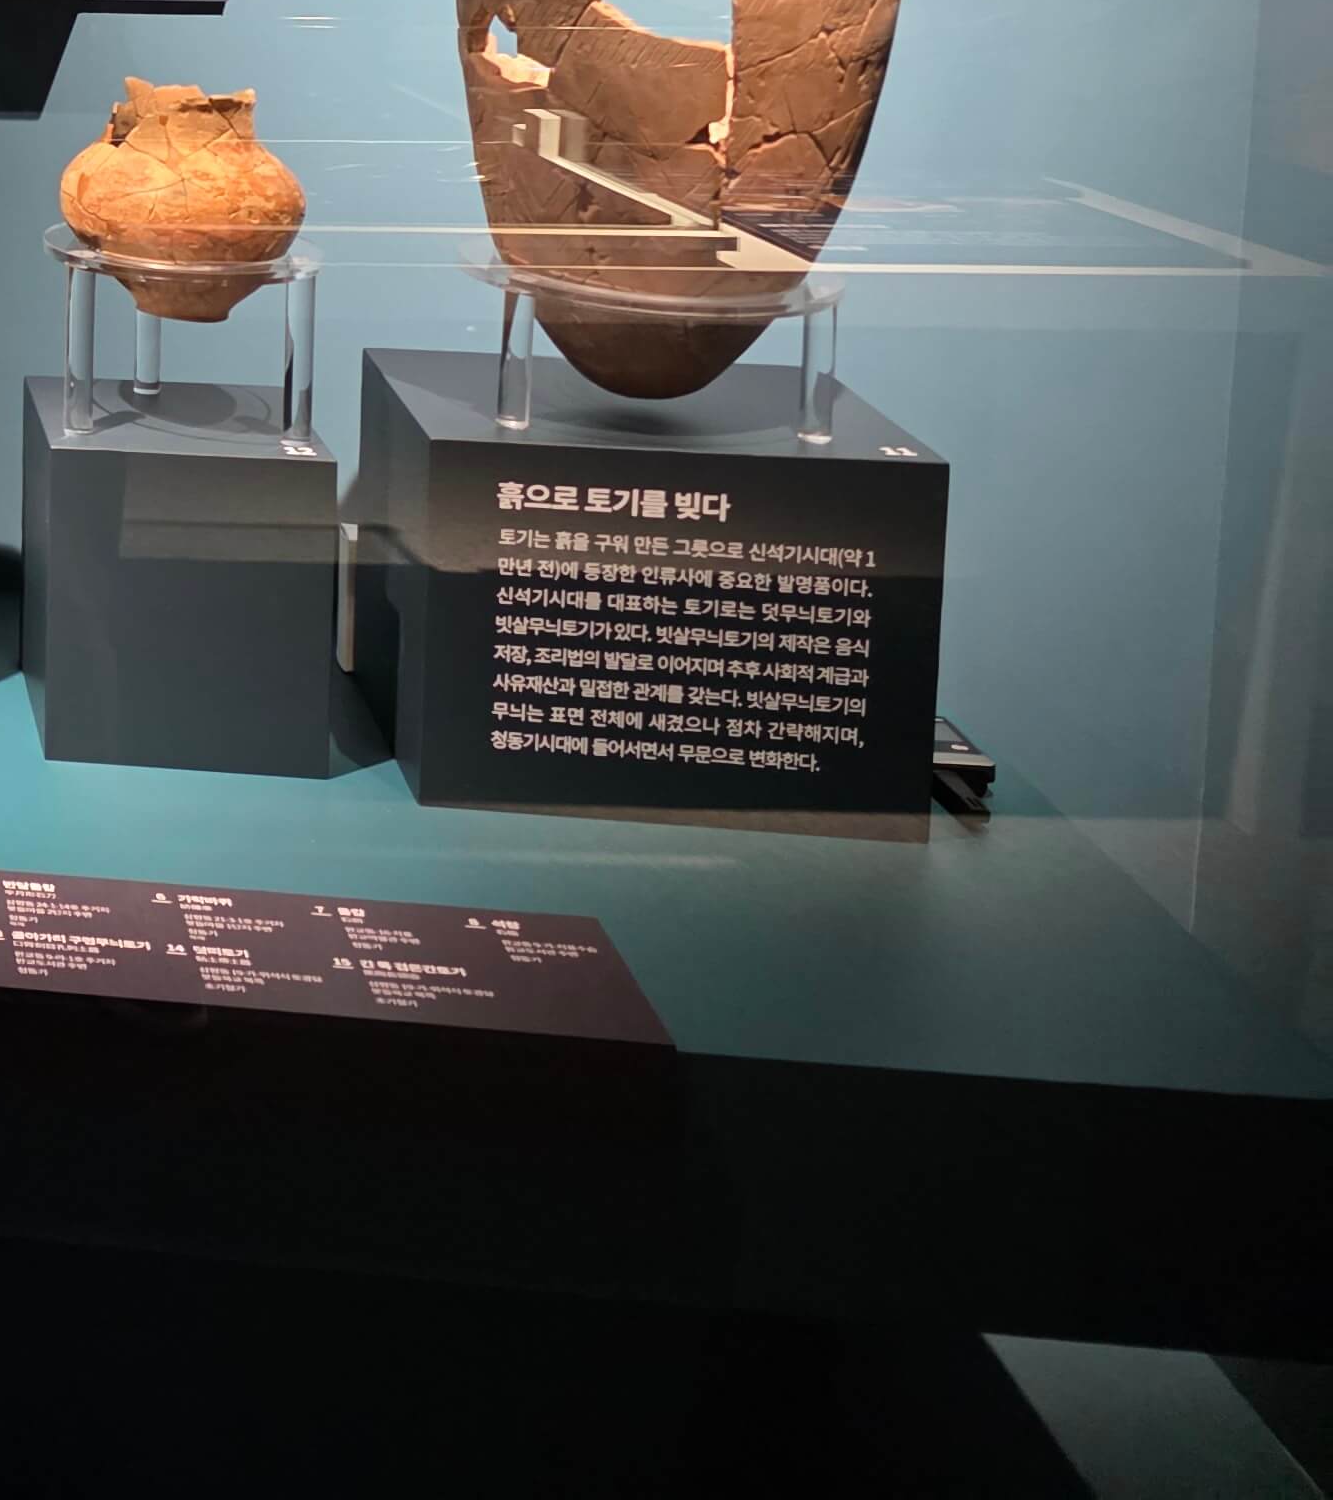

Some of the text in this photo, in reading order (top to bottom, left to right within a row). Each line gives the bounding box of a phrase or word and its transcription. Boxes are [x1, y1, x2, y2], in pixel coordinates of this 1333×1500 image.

[497, 482, 730, 522] 흙으로 토기를 빚다
[498, 557, 872, 597] 만년 전)에 등장한 인류사에 중요한 발명품이다.
